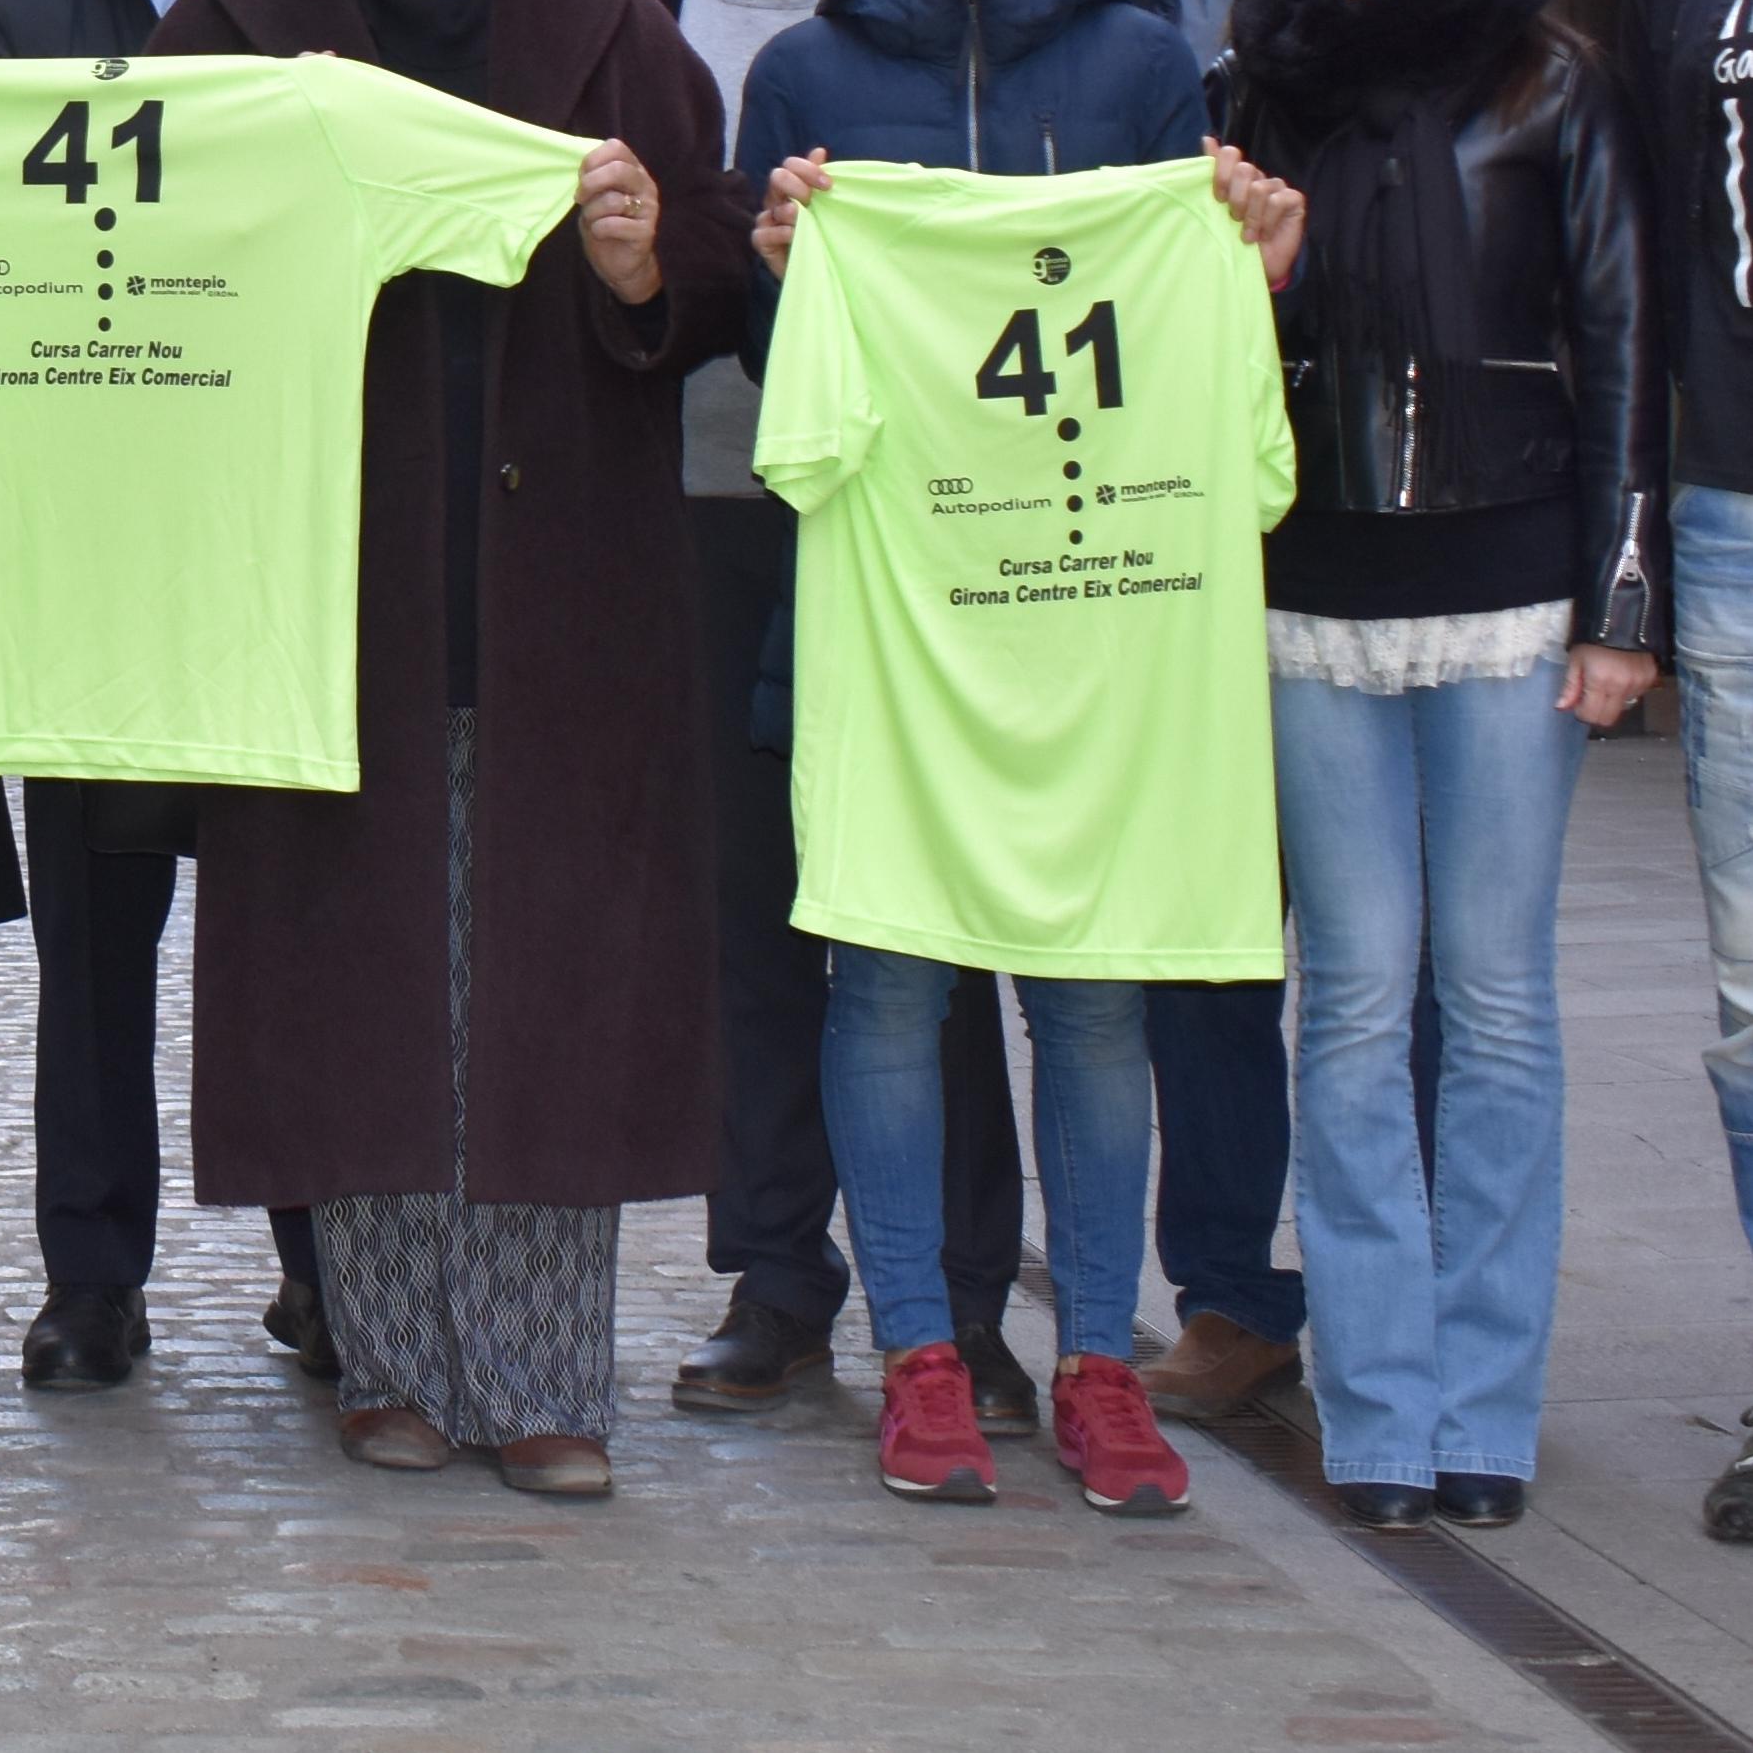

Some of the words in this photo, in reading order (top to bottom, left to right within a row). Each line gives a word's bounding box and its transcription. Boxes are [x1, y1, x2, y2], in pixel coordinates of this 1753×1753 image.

[22, 100, 164, 204] 41
[151, 275, 226, 292] montepio
[30, 341, 81, 358] Cursa
[87, 341, 143, 358] Carrer
[148, 341, 182, 359] Nou
[975, 300, 1123, 416] 41
[45, 367, 103, 386] Centre
[108, 368, 136, 385] Eix
[141, 368, 231, 388] Comercial
[1120, 475, 1191, 493] montepio
[931, 497, 1052, 517] Autopodium
[999, 559, 1052, 577] Cursa
[1059, 554, 1118, 573] Carrer
[1123, 550, 1154, 567] Nou
[950, 587, 1009, 606] Girona
[1016, 584, 1078, 603] Centre
[1083, 580, 1112, 599] Eix
[1118, 573, 1203, 595] Comercial
